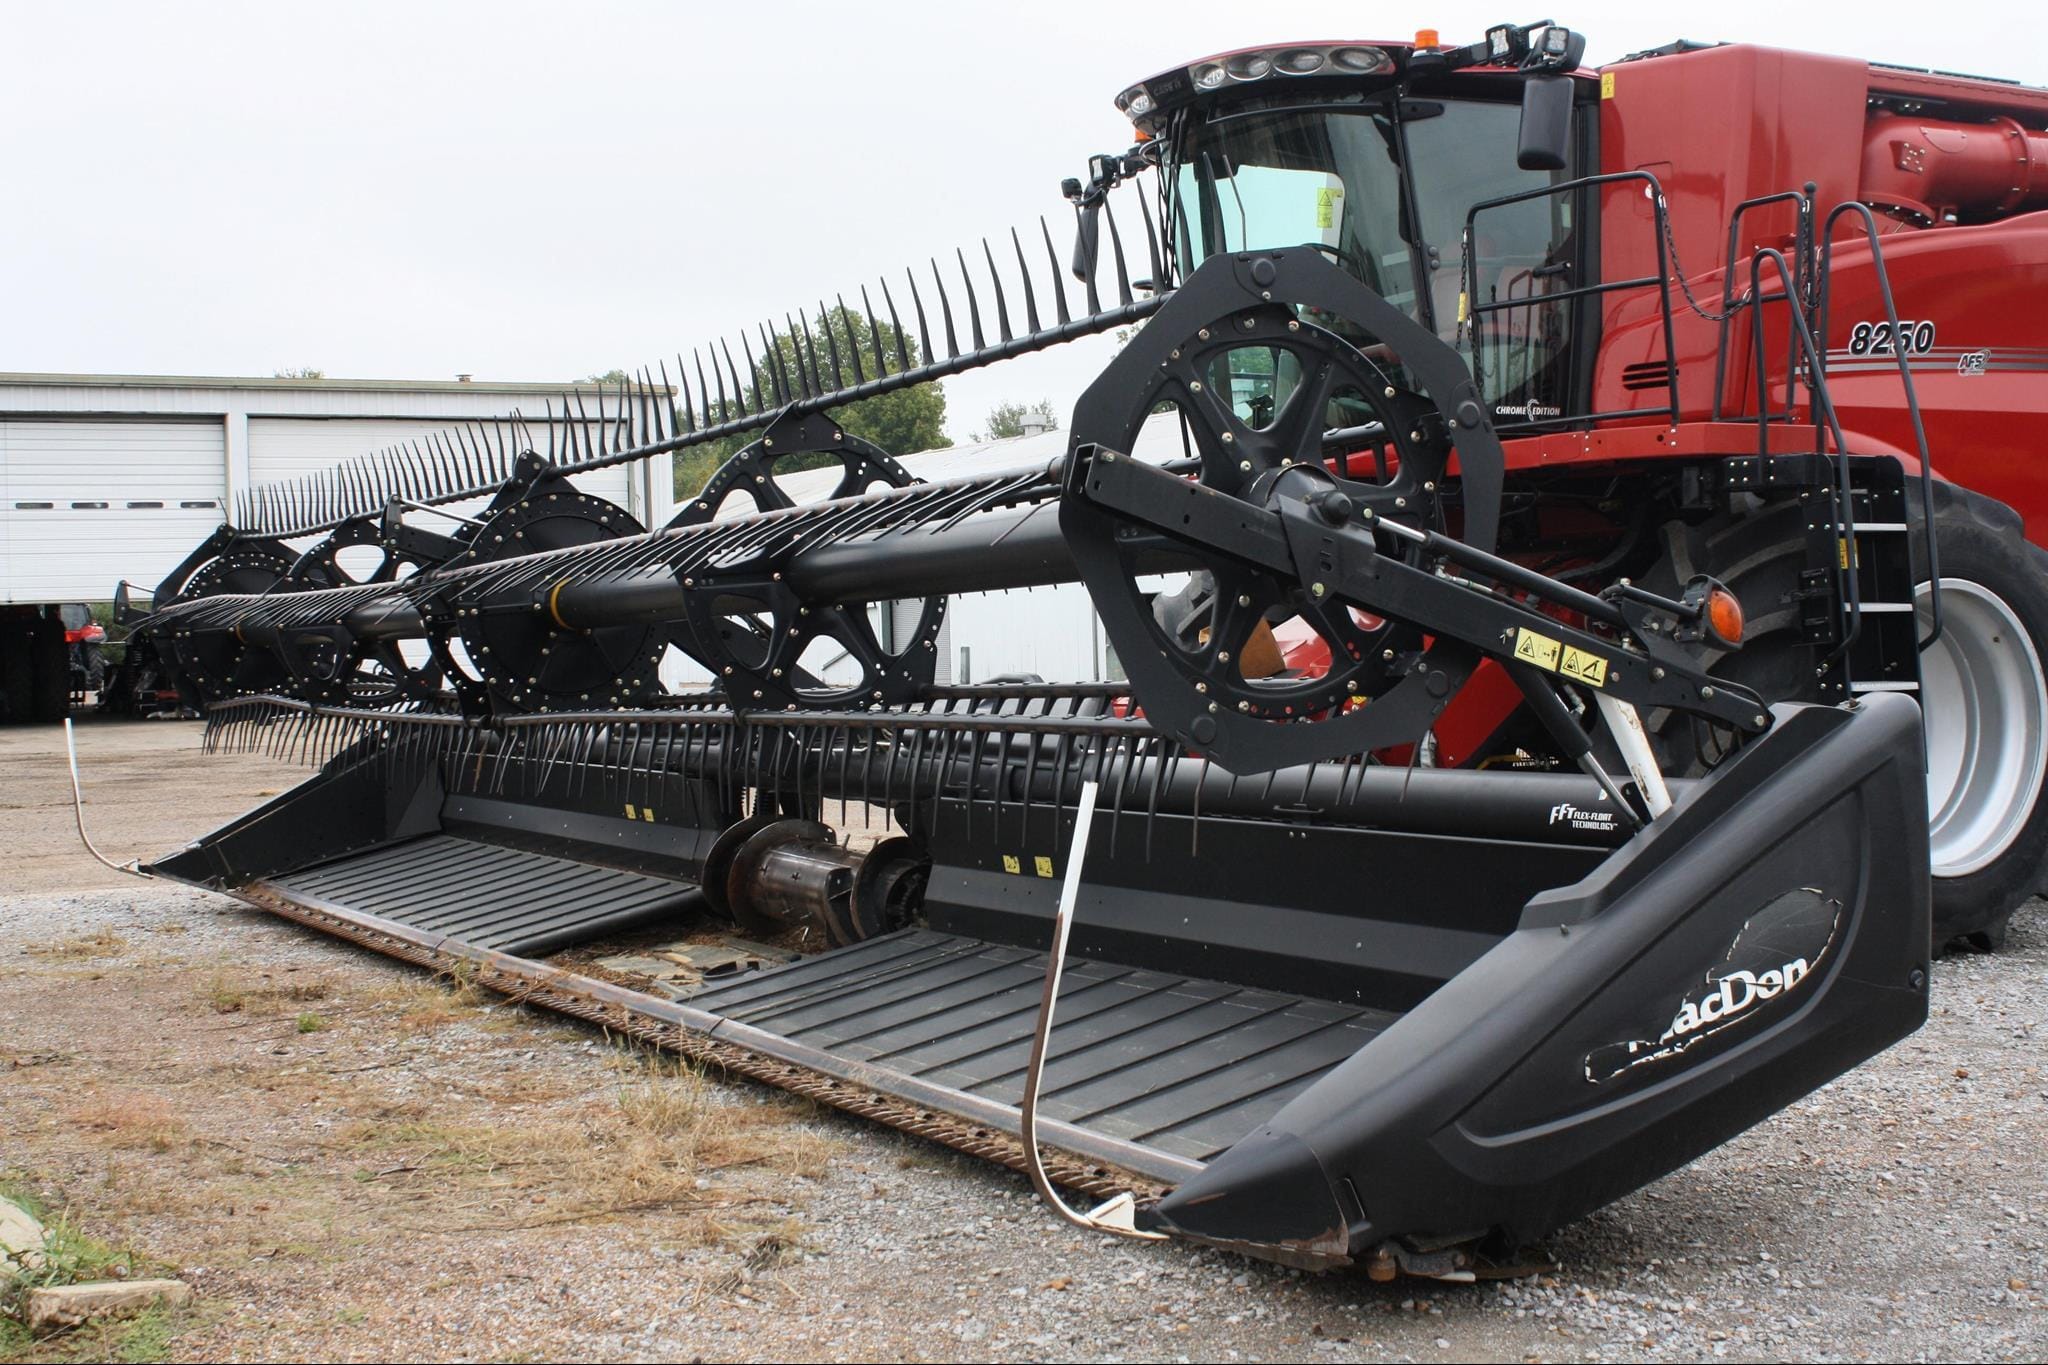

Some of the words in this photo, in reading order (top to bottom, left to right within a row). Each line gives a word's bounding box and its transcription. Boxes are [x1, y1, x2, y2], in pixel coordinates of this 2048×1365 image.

[1848, 320, 1935, 355] 8250
[1957, 353, 1984, 370] AFS
[1495, 406, 1526, 415] CHROME
[1532, 406, 1561, 416] EDITION
[1549, 803, 1576, 825] FFT
